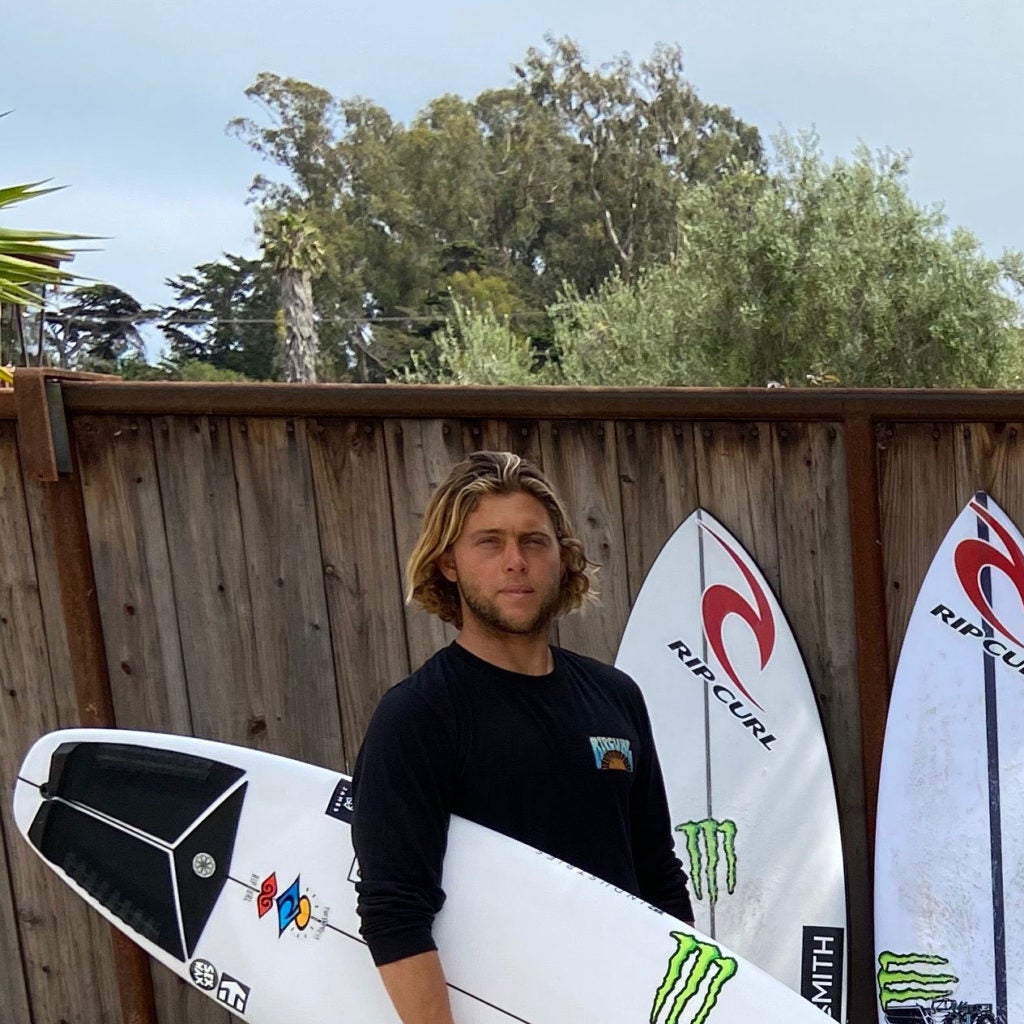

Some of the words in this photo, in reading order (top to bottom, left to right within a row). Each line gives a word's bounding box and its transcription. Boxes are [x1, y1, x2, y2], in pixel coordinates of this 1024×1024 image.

[930, 604, 984, 637] RIP
[667, 640, 716, 681] RIP
[713, 685, 777, 751] CURL
